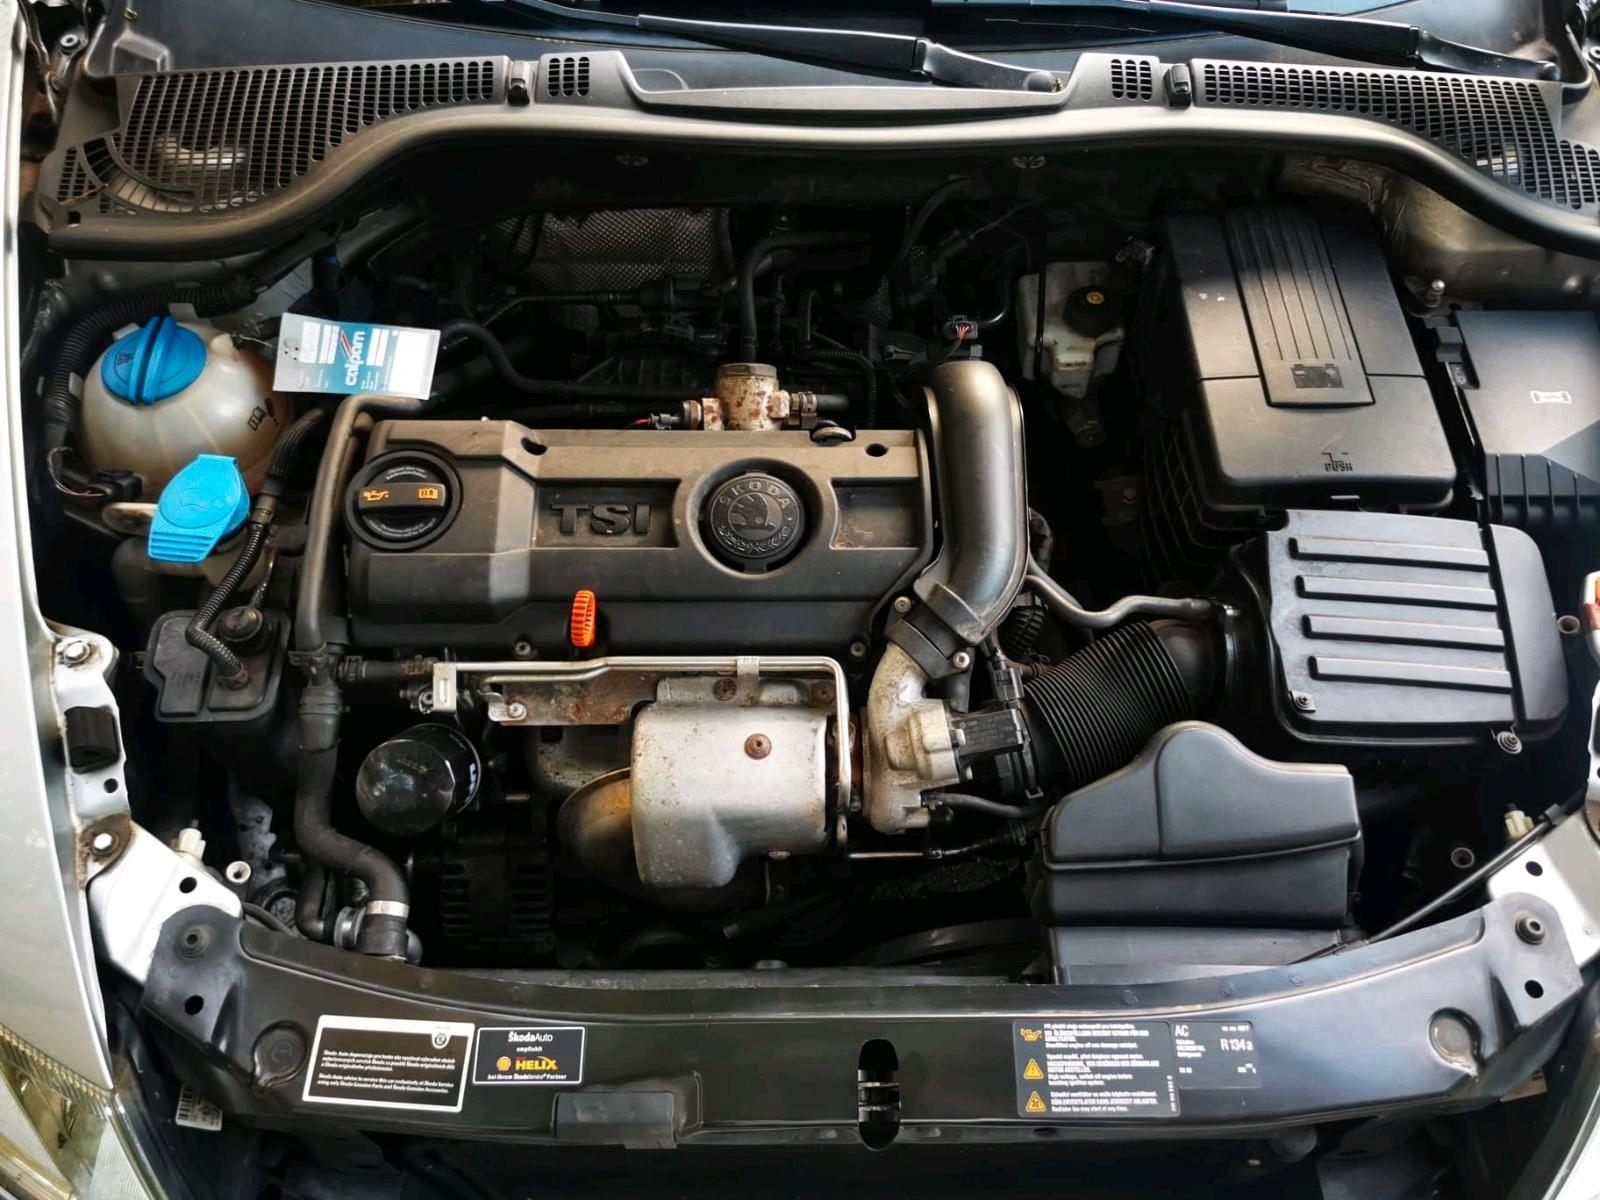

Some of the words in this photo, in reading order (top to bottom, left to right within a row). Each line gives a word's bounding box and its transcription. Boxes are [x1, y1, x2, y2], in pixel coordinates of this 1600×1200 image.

[345, 330, 366, 386] calpam
[551, 503, 652, 535] TSI
[1175, 1024, 1189, 1037] AC
[516, 1056, 559, 1071] HELIX
